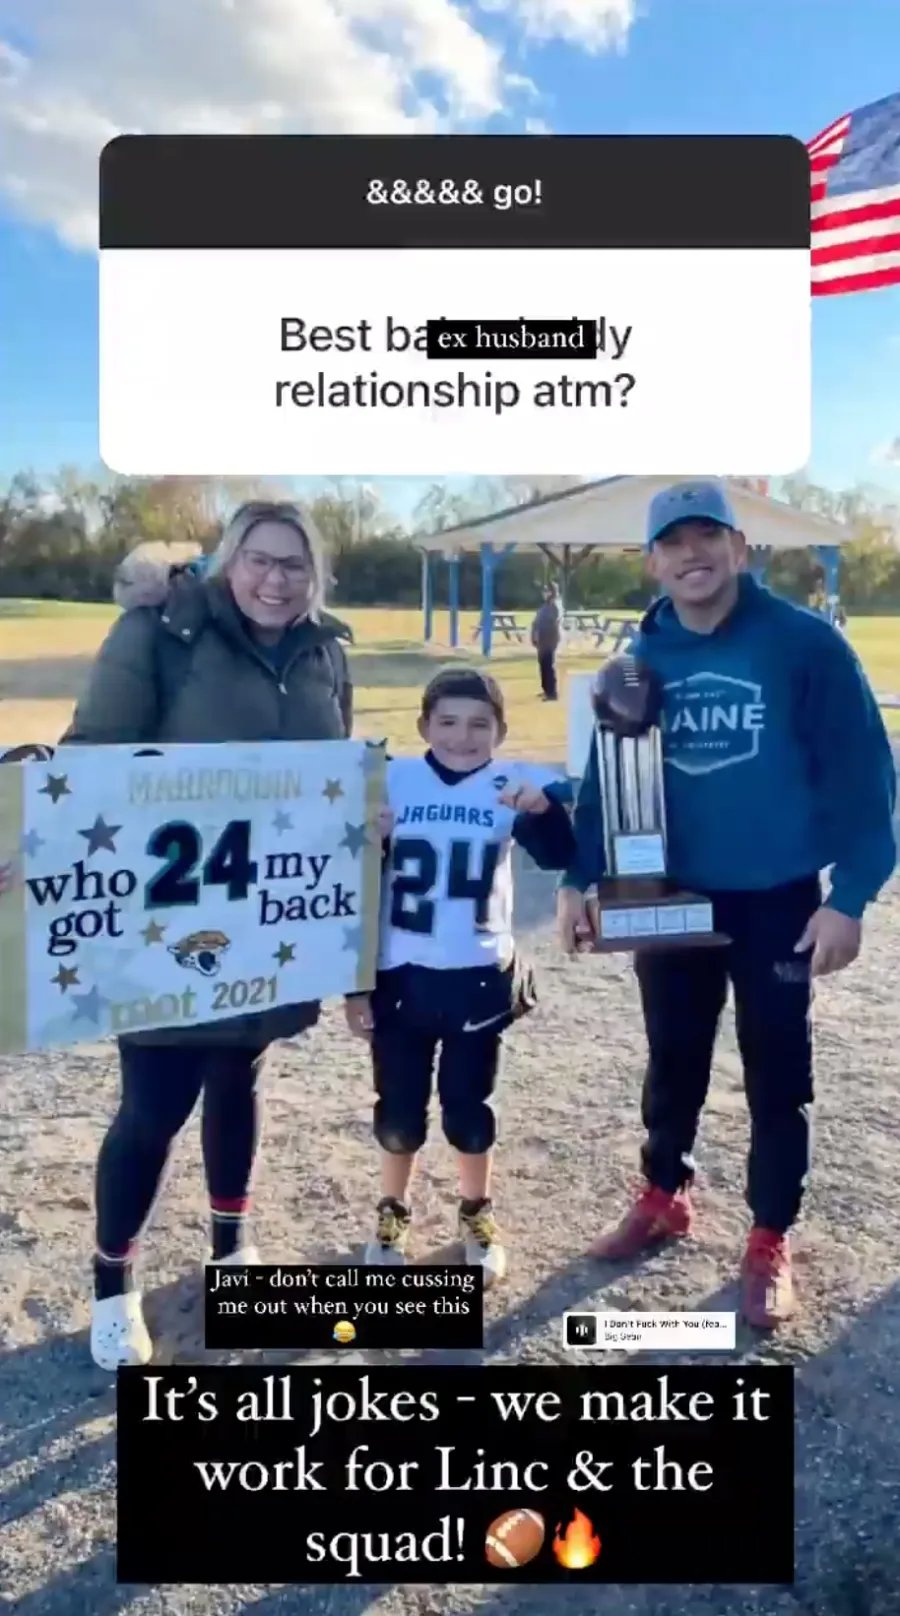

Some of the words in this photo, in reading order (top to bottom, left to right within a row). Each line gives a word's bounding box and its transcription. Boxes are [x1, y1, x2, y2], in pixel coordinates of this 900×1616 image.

[659, 703, 766, 732] AINE
[396, 803, 494, 828] JAGUARS
[26, 859, 137, 906] who
[144, 819, 258, 910] 24
[264, 850, 332, 890] my
[258, 885, 357, 926] back
[390, 837, 500, 934] 24
[47, 901, 124, 956] got
[211, 974, 278, 1012] 2021
